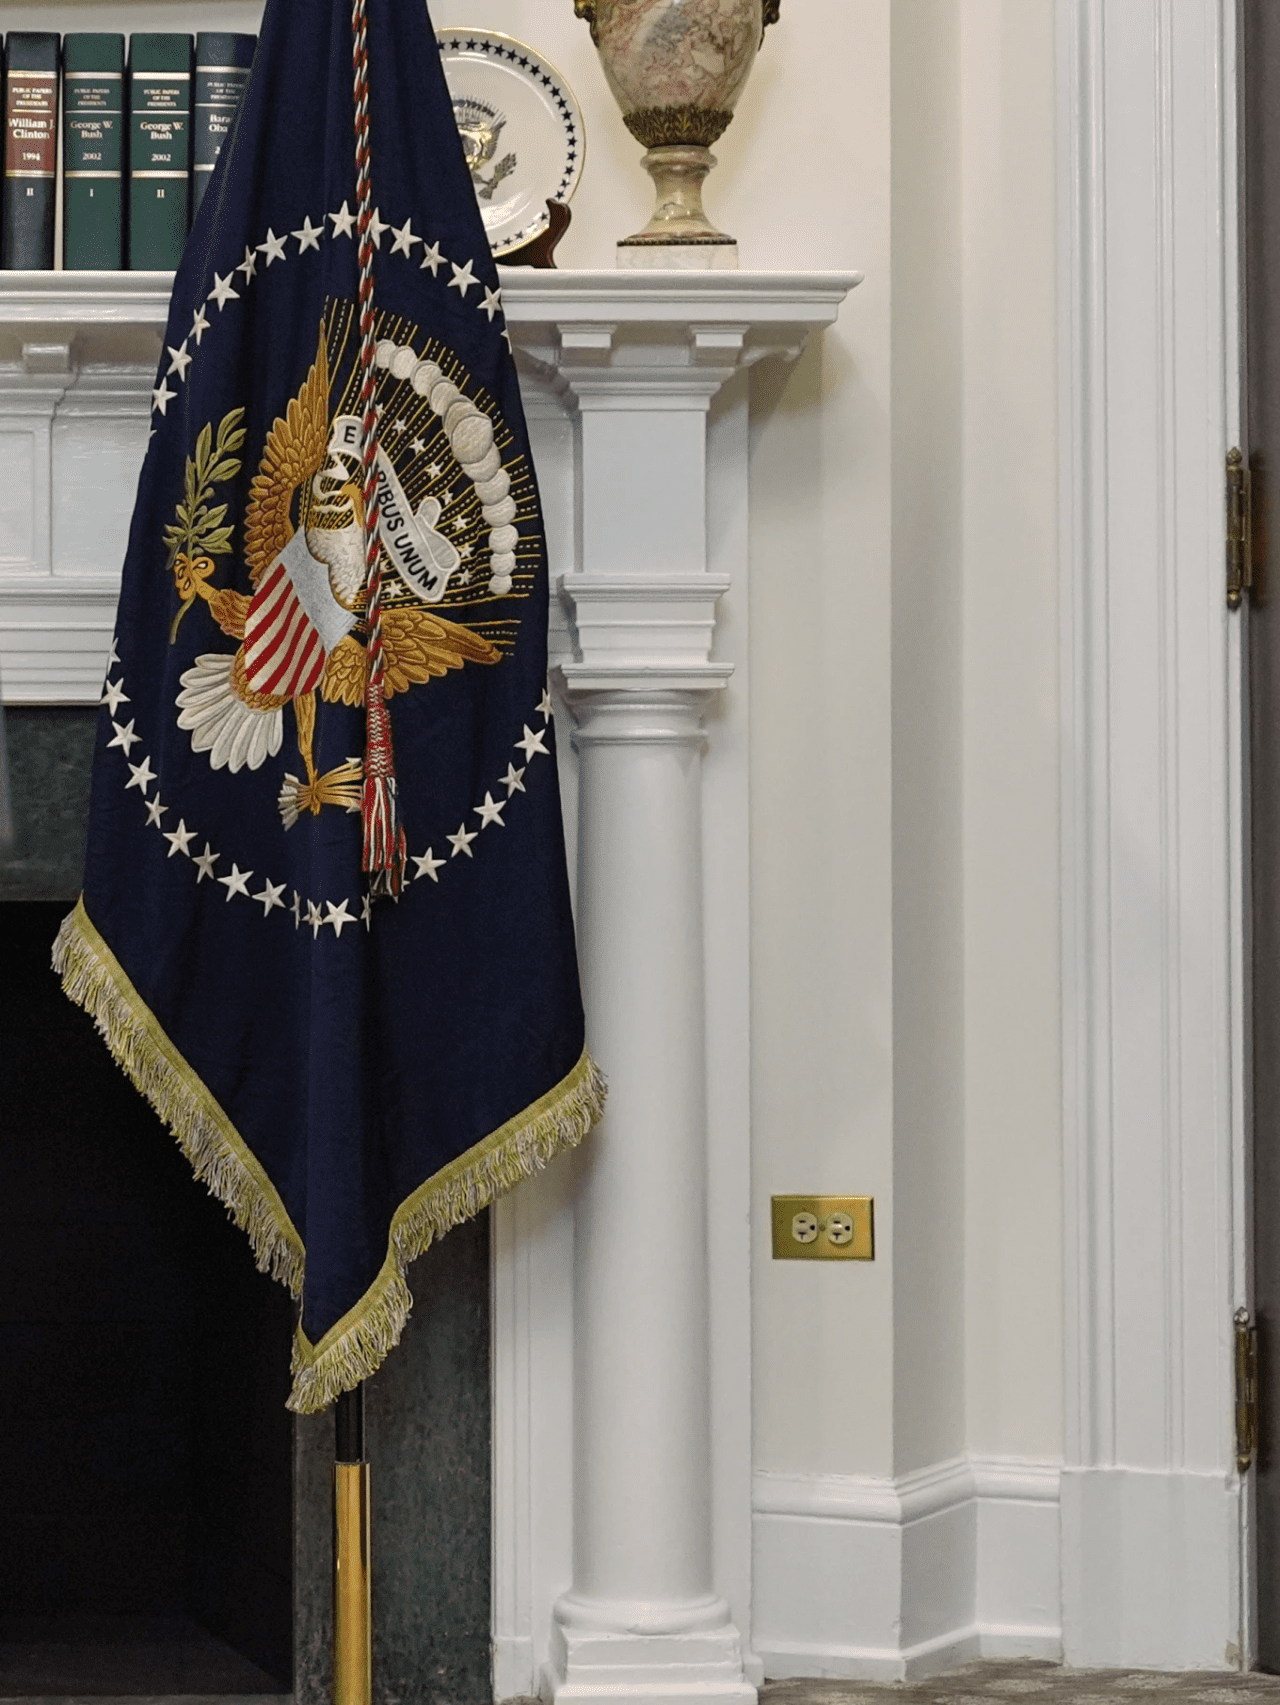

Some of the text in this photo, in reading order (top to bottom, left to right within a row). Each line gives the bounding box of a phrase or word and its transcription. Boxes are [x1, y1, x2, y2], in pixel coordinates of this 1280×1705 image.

[8, 118, 47, 128] William
[209, 114, 233, 123] Bara
[70, 120, 113, 130] George W.
[140, 121, 184, 132] George W.
[208, 123, 228, 133] Oba
[12, 128, 50, 139] Clinton
[81, 130, 103, 139] Bush
[150, 131, 172, 140] Bush
[23, 152, 41, 161] 1994
[82, 152, 102, 160] 2002
[151, 153, 171, 162] 2002
[26, 187, 34, 196] II
[156, 188, 165, 199] II
[343, 425, 357, 444] E
[394, 532, 438, 591] UNUM
